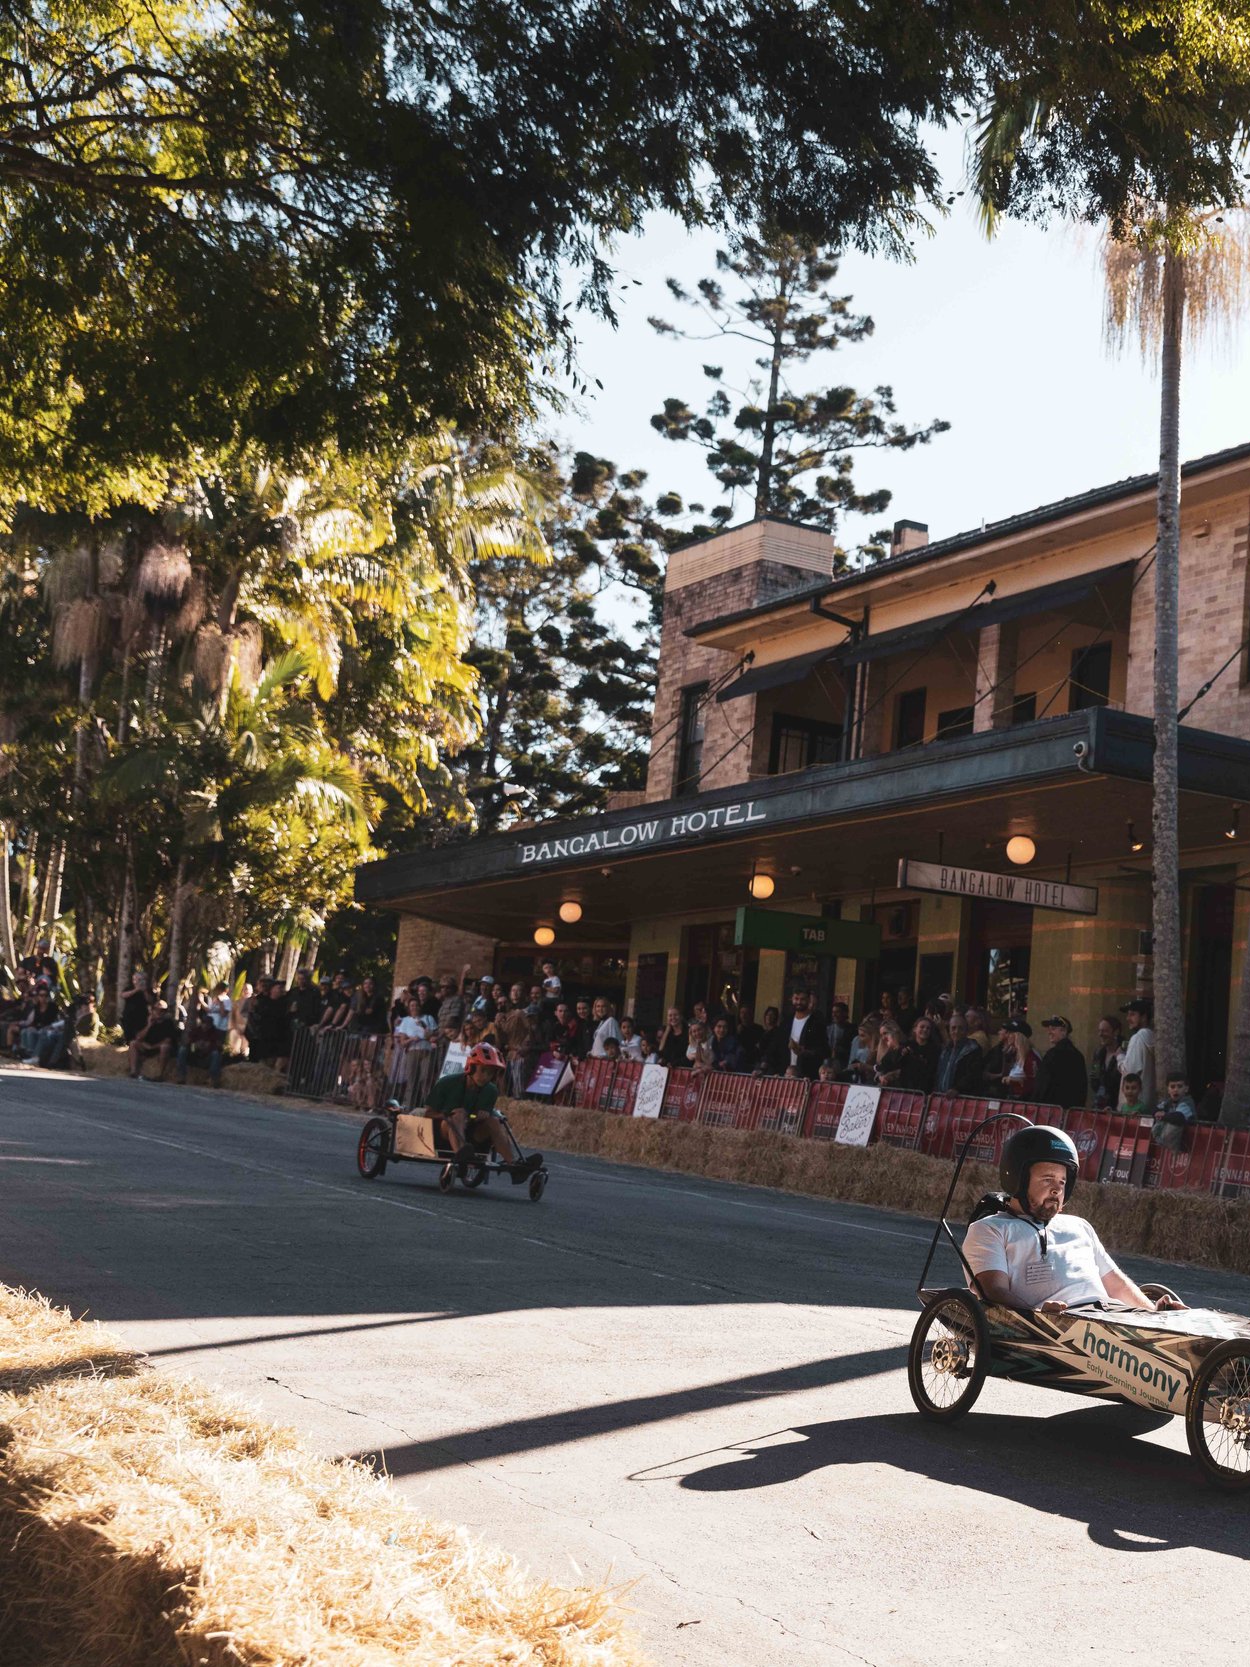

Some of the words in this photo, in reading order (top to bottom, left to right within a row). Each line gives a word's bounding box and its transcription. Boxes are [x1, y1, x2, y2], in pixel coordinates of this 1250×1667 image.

[521, 820, 659, 864] BANGALOW
[670, 802, 766, 837] HOTEL
[940, 867, 1016, 899] BANGALOW
[1024, 880, 1066, 907] HOTEL
[801, 927, 825, 942] TAB
[1082, 1323, 1181, 1403] harmony
[1086, 1360, 1104, 1378] Early
[1105, 1371, 1137, 1396] Learning
[1139, 1388, 1170, 1410] Journey
